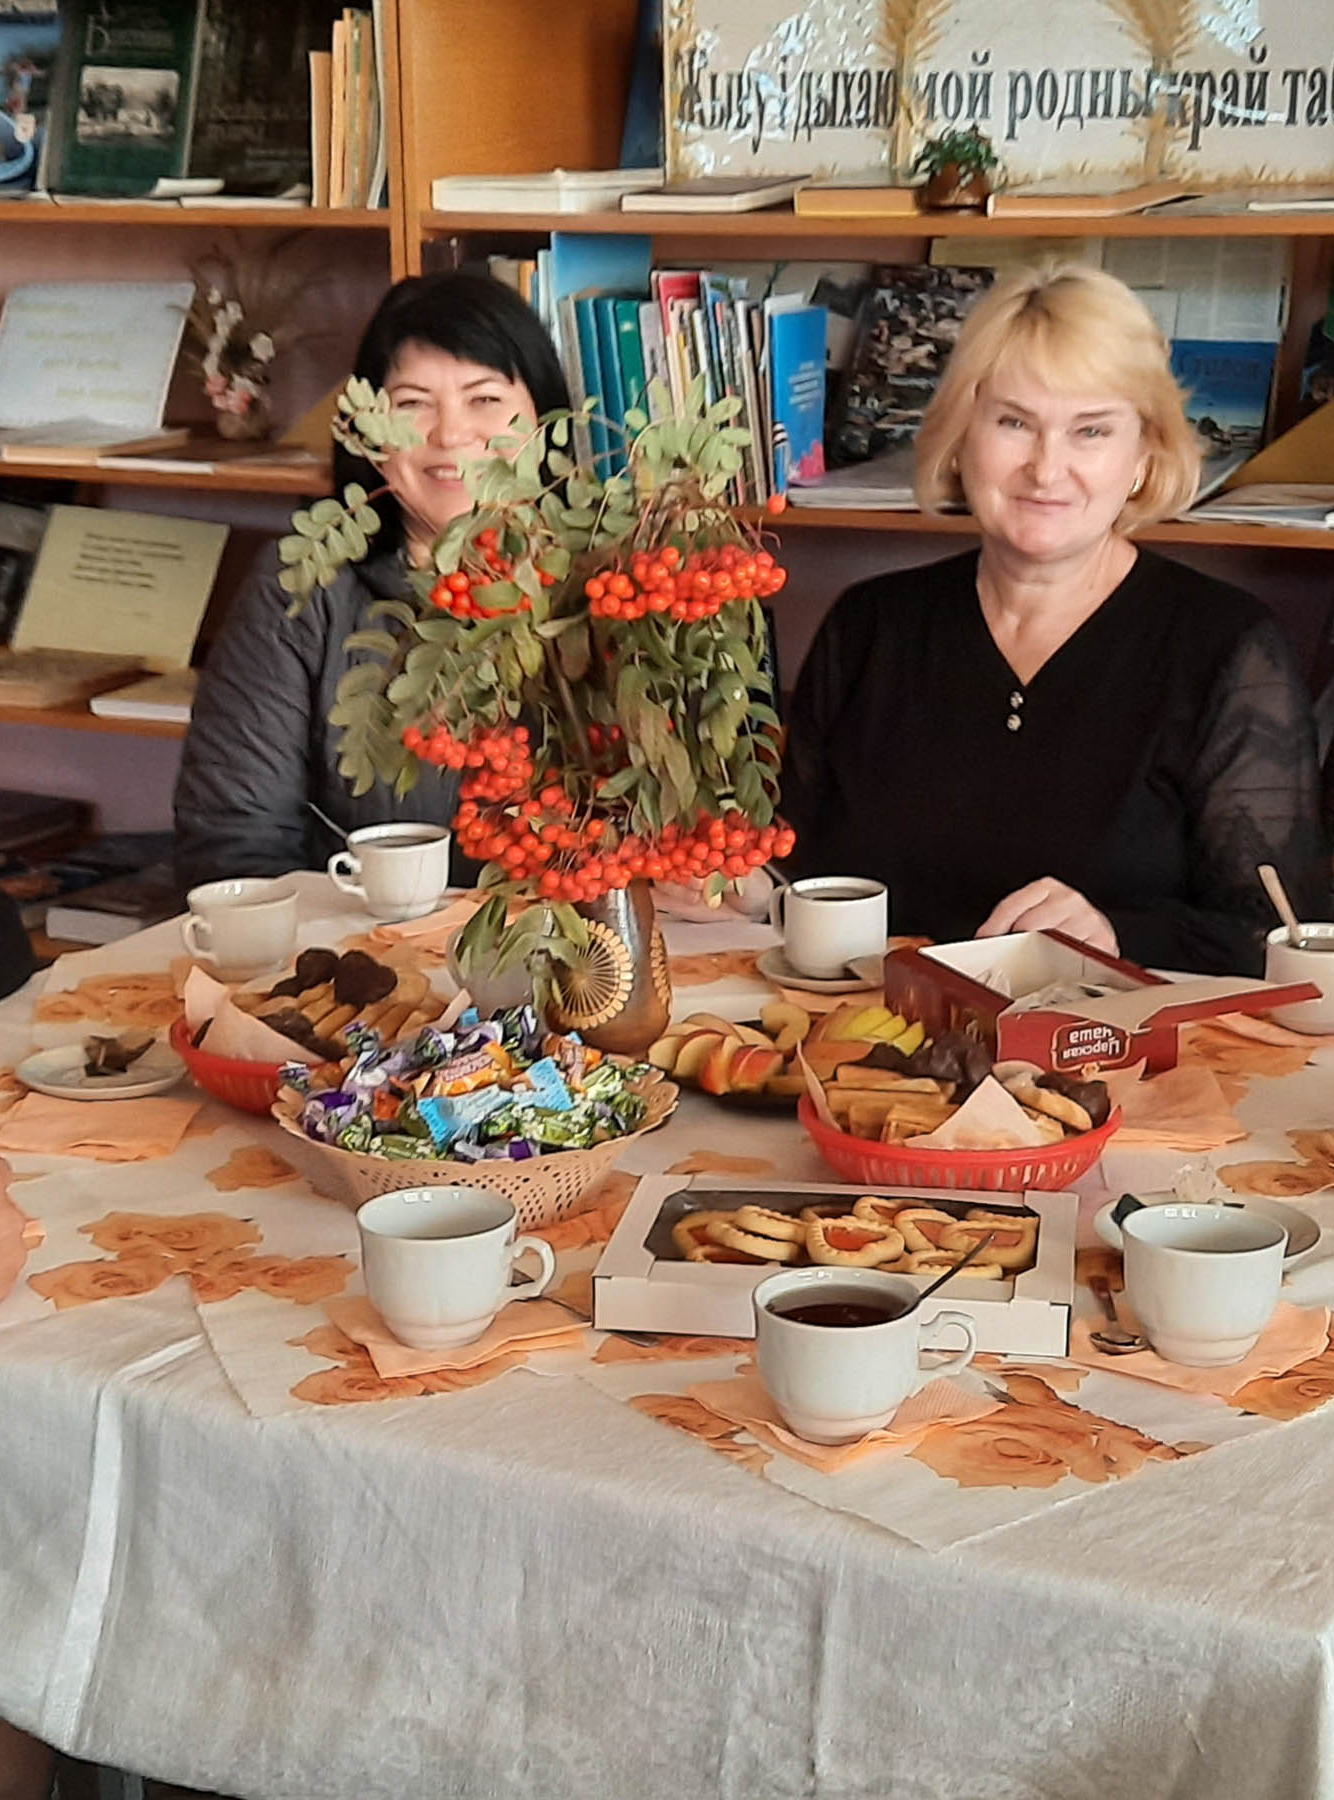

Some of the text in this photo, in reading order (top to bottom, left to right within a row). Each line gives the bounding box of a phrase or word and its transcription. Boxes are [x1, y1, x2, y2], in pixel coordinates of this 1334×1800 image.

[1005, 67, 1156, 141] родны
[1164, 46, 1269, 151] край
[1069, 1026, 1113, 1044] чаша
[1062, 1036, 1120, 1060] Царская
